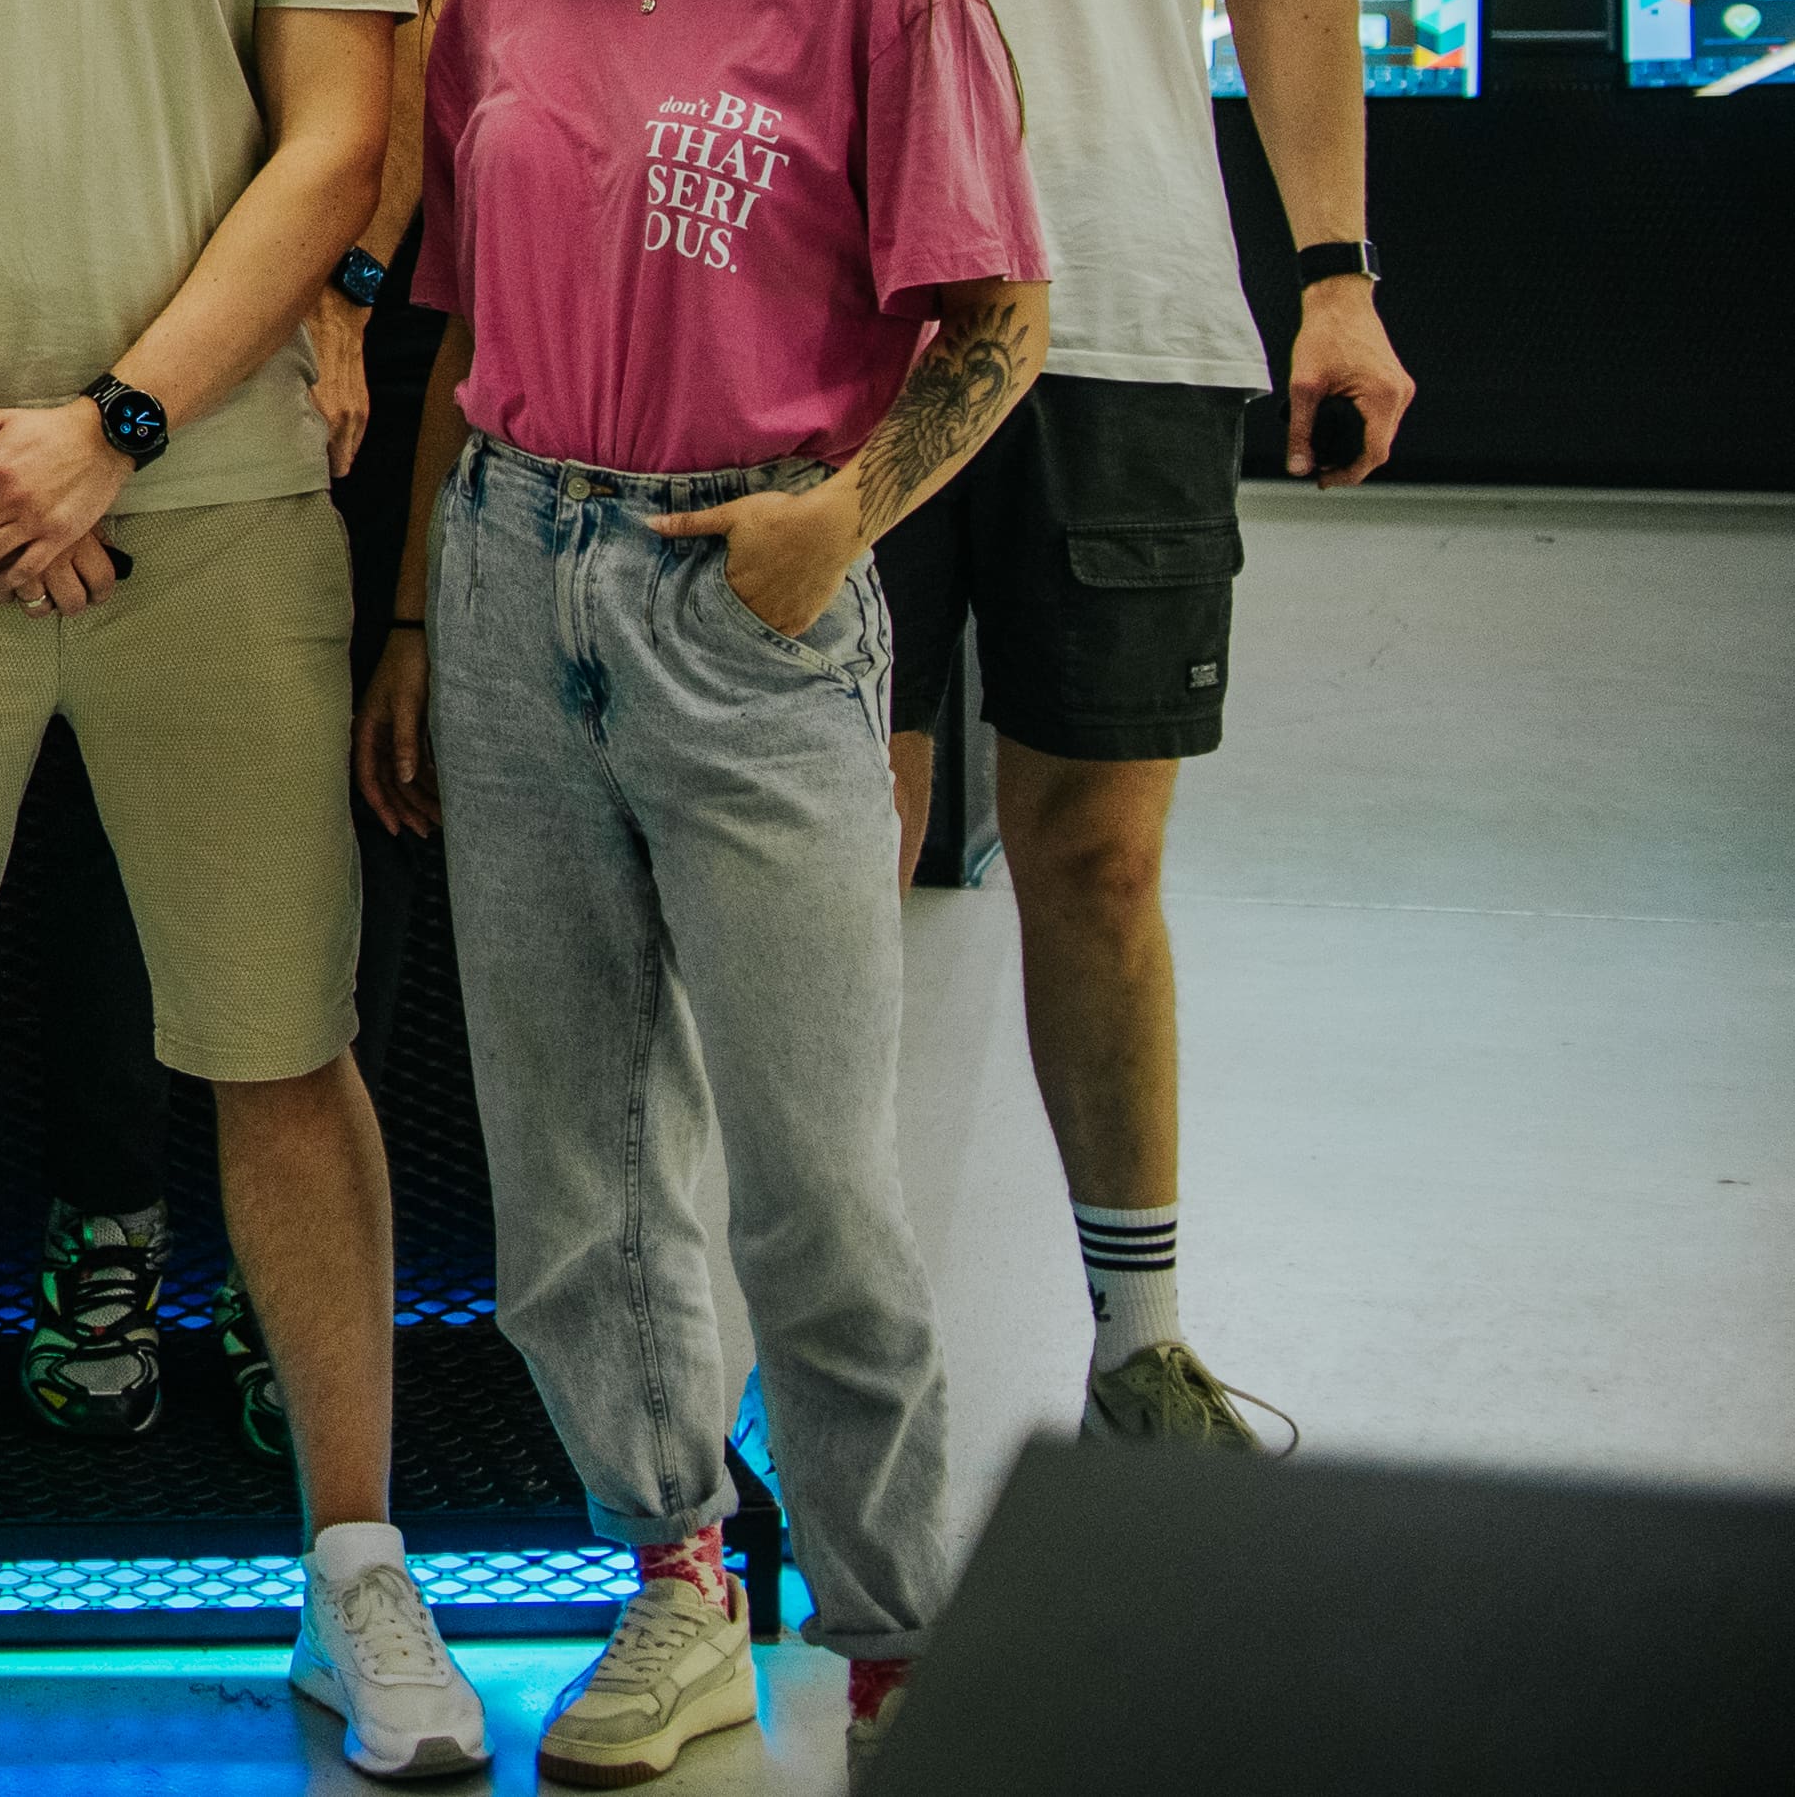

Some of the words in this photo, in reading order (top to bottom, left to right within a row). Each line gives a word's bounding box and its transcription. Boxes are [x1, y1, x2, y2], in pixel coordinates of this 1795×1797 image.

[659, 95, 712, 118] don't
[708, 90, 783, 144] BE
[644, 120, 791, 191] THAT
[647, 164, 762, 230] SERI
